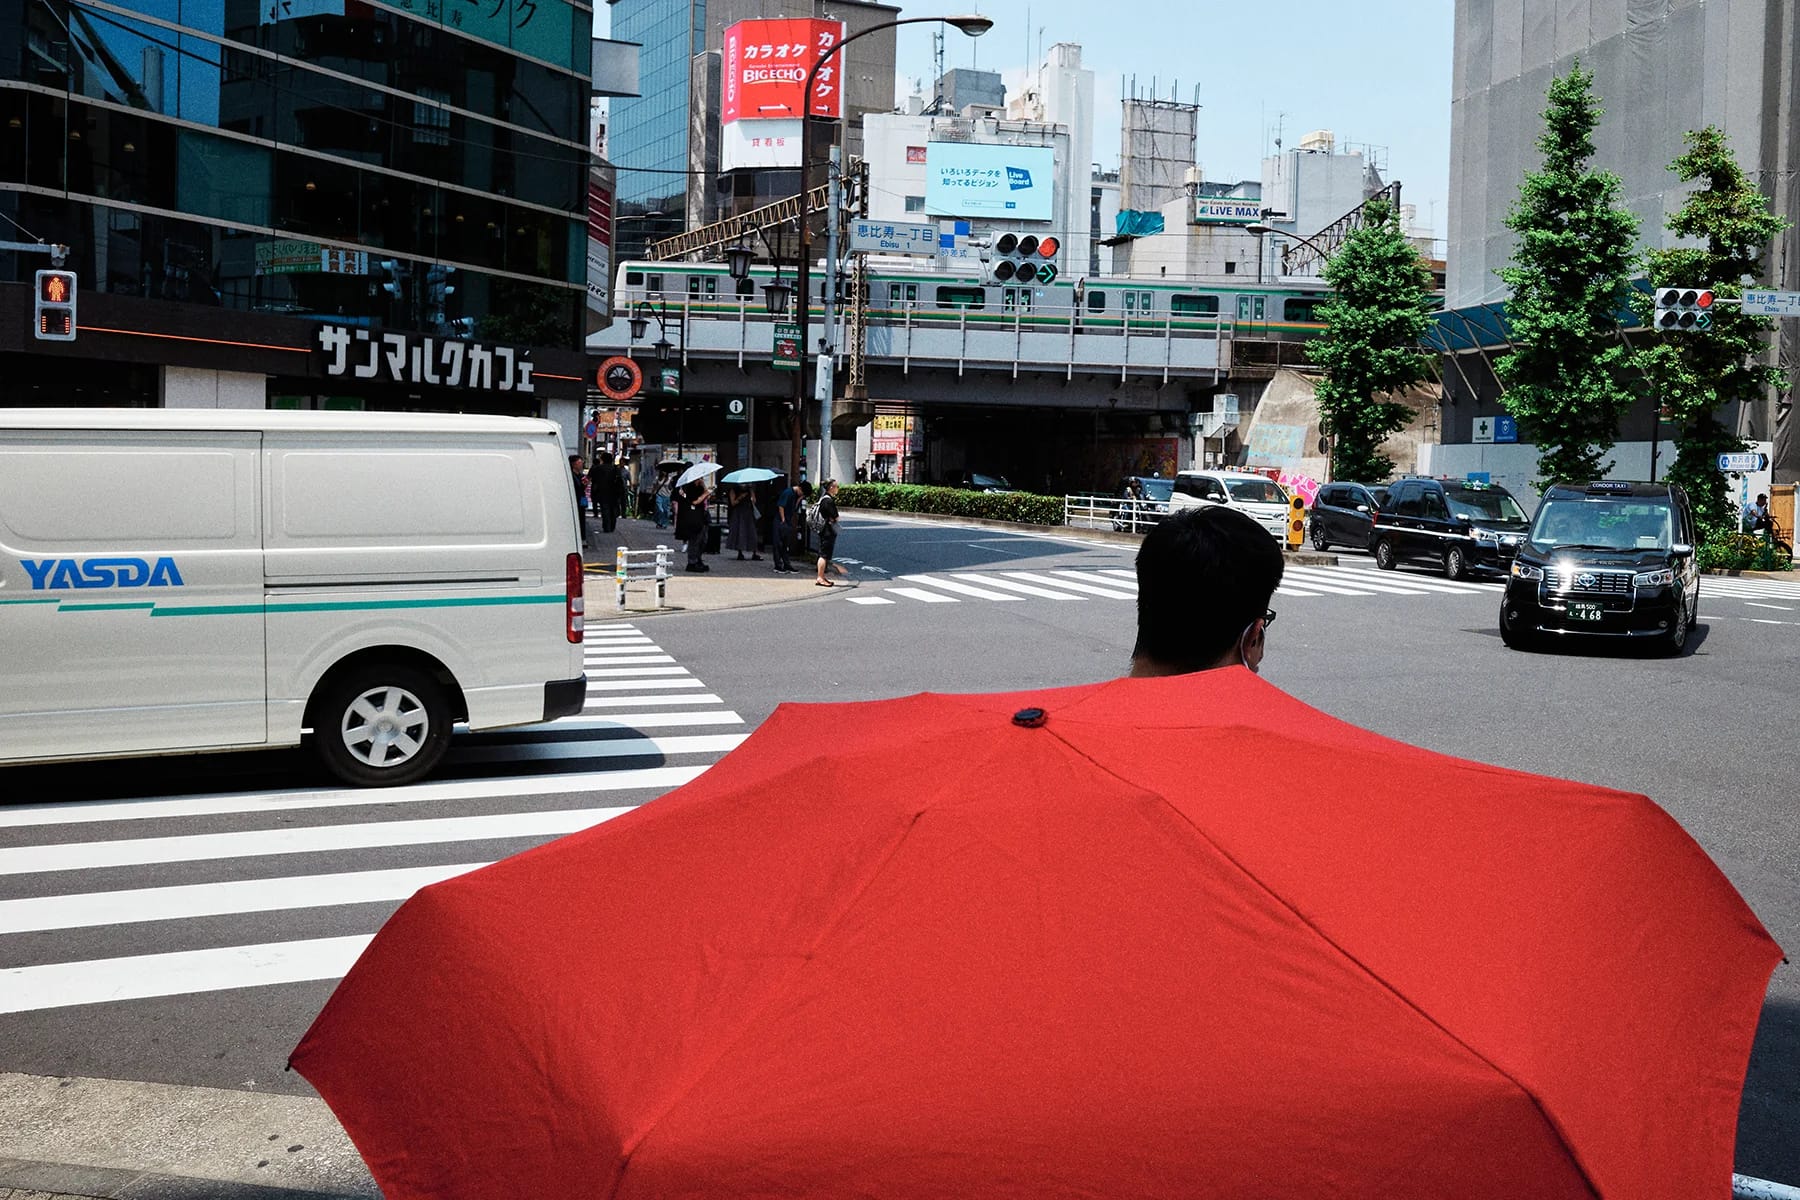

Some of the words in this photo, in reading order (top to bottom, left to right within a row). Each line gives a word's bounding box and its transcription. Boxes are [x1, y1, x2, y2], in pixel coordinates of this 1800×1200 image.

[744, 44, 807, 59] カラオケ
[816, 32, 834, 97] カラオケ
[743, 69, 768, 83] BIG
[769, 68, 807, 81] ECHO
[940, 168, 1000, 177] いろいろデータを
[942, 178, 998, 187] 知ってるビジョン
[1235, 207, 1259, 216] MAX
[857, 225, 933, 241] 恵比寿一丁目
[880, 240, 899, 249] Ebisu
[319, 325, 534, 393] サンマルクカフェ
[19, 557, 184, 590] YASDA
